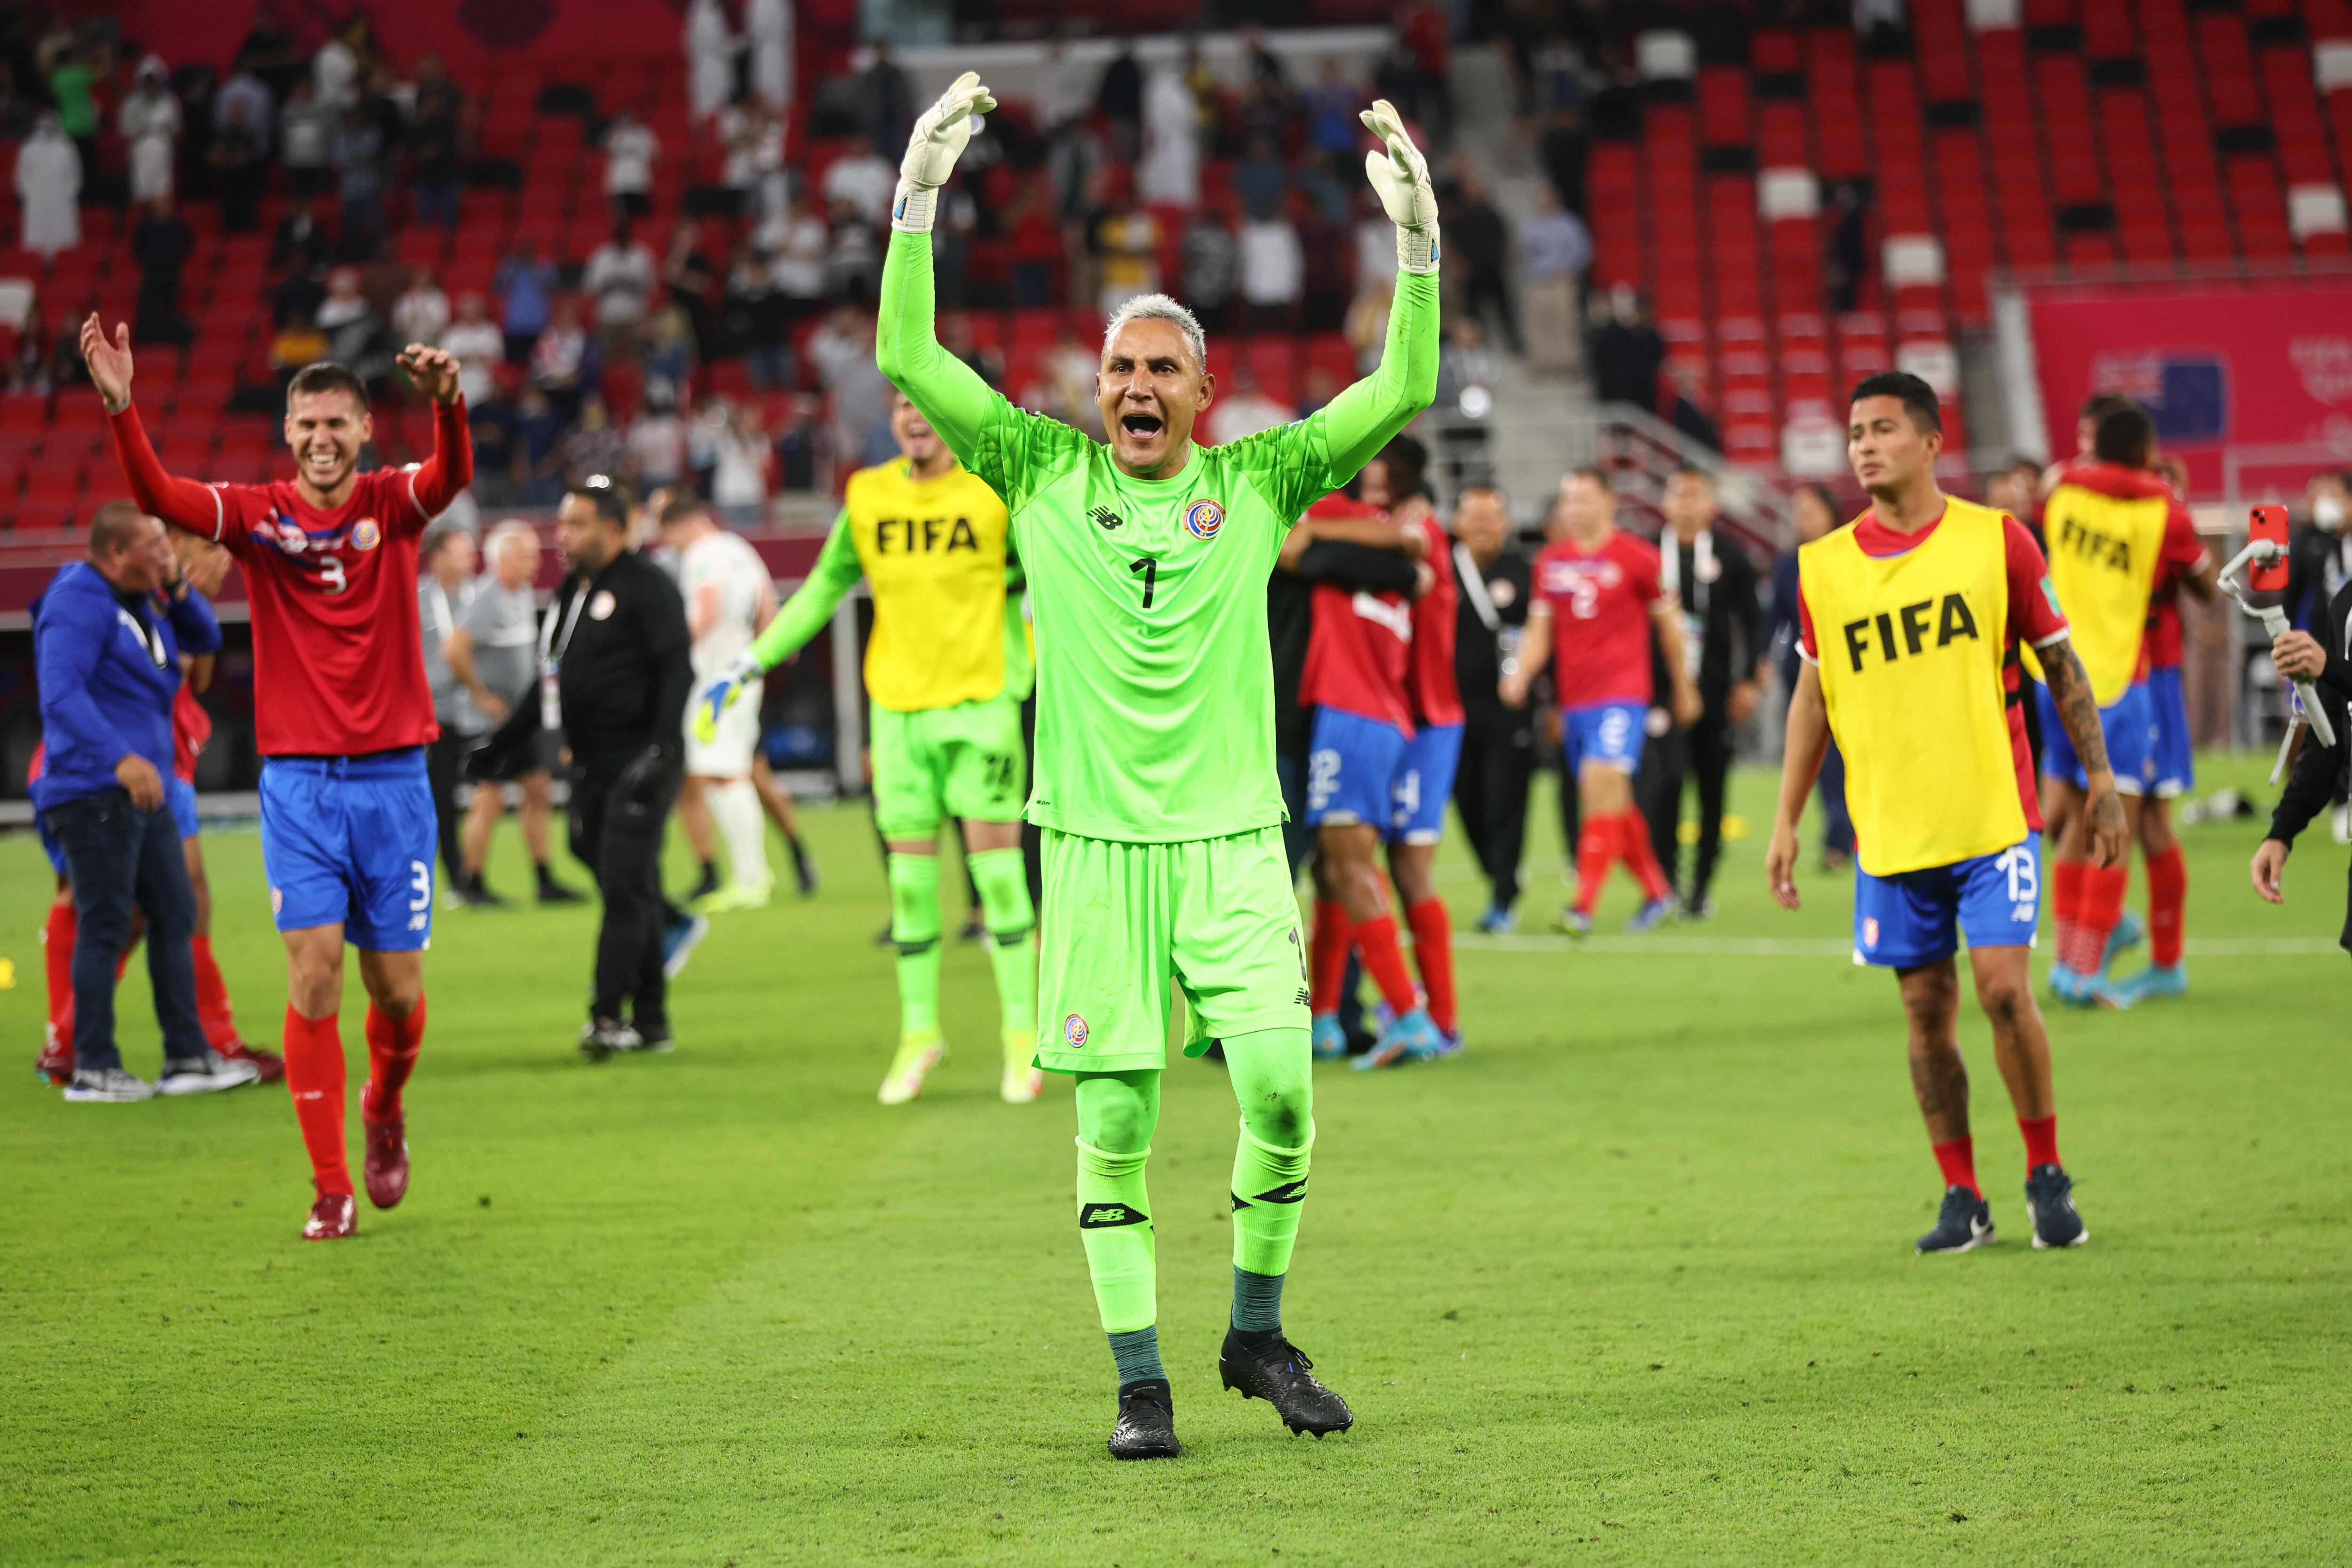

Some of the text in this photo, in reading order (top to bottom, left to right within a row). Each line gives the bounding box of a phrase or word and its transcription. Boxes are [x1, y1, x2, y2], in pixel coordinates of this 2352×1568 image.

[878, 518, 977, 553] FIFA
[2060, 520, 2130, 574] FIFA
[320, 556, 347, 596] 3
[1129, 558, 1157, 609] 1
[1844, 593, 1979, 672] FIFA
[409, 860, 431, 912] 3
[1994, 846, 2038, 902] 13
